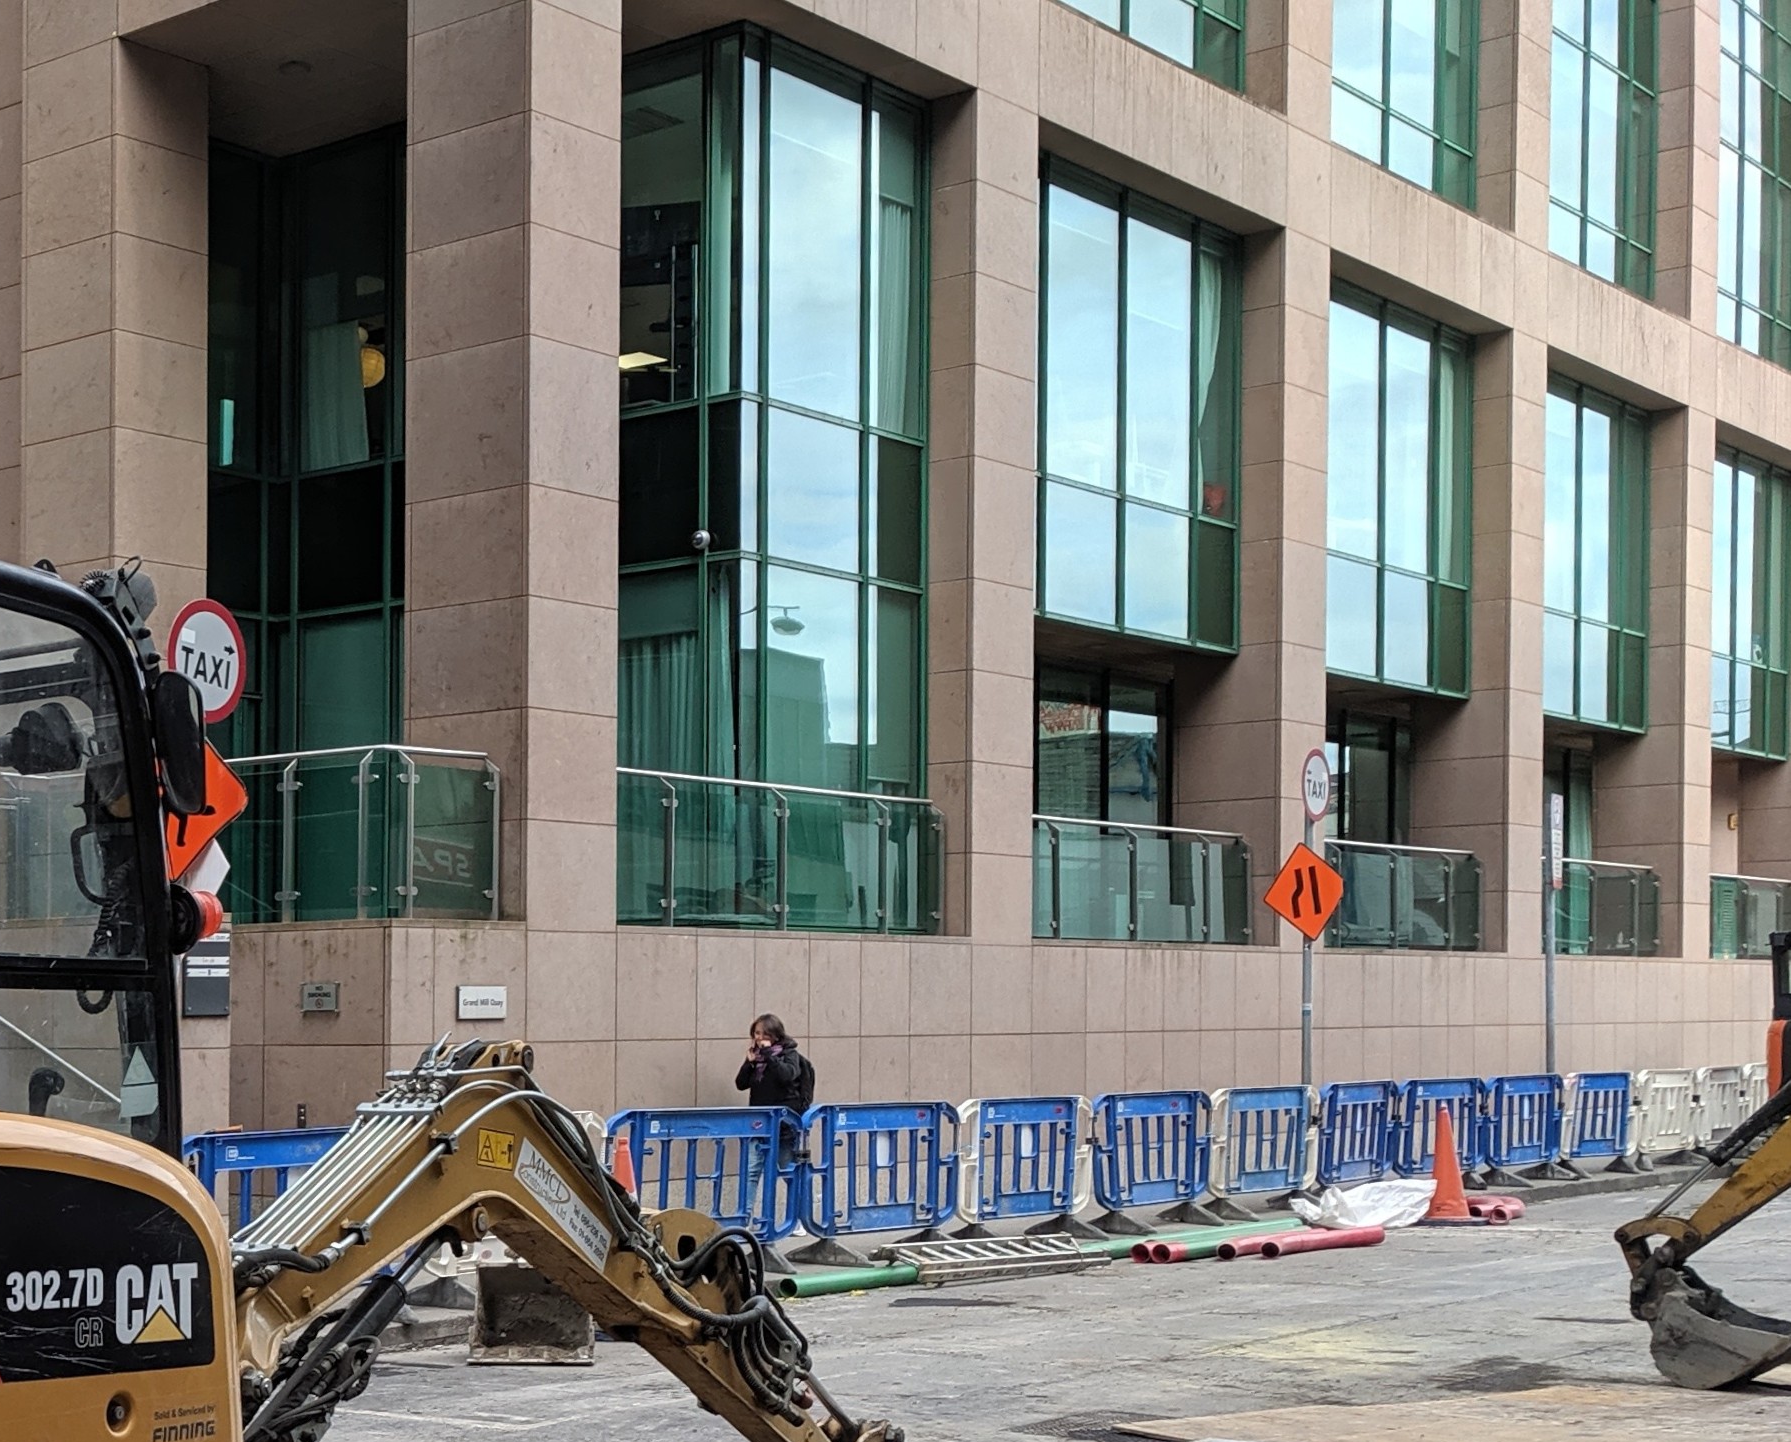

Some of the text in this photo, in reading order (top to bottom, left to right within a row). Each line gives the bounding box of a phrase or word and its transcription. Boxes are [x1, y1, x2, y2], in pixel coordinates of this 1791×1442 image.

[181, 645, 231, 690] TAXI
[1307, 779, 1326, 800] TAXI
[6, 1268, 104, 1312] 302.7D
[116, 1262, 198, 1344] CAT
[75, 1317, 104, 1348] CR
